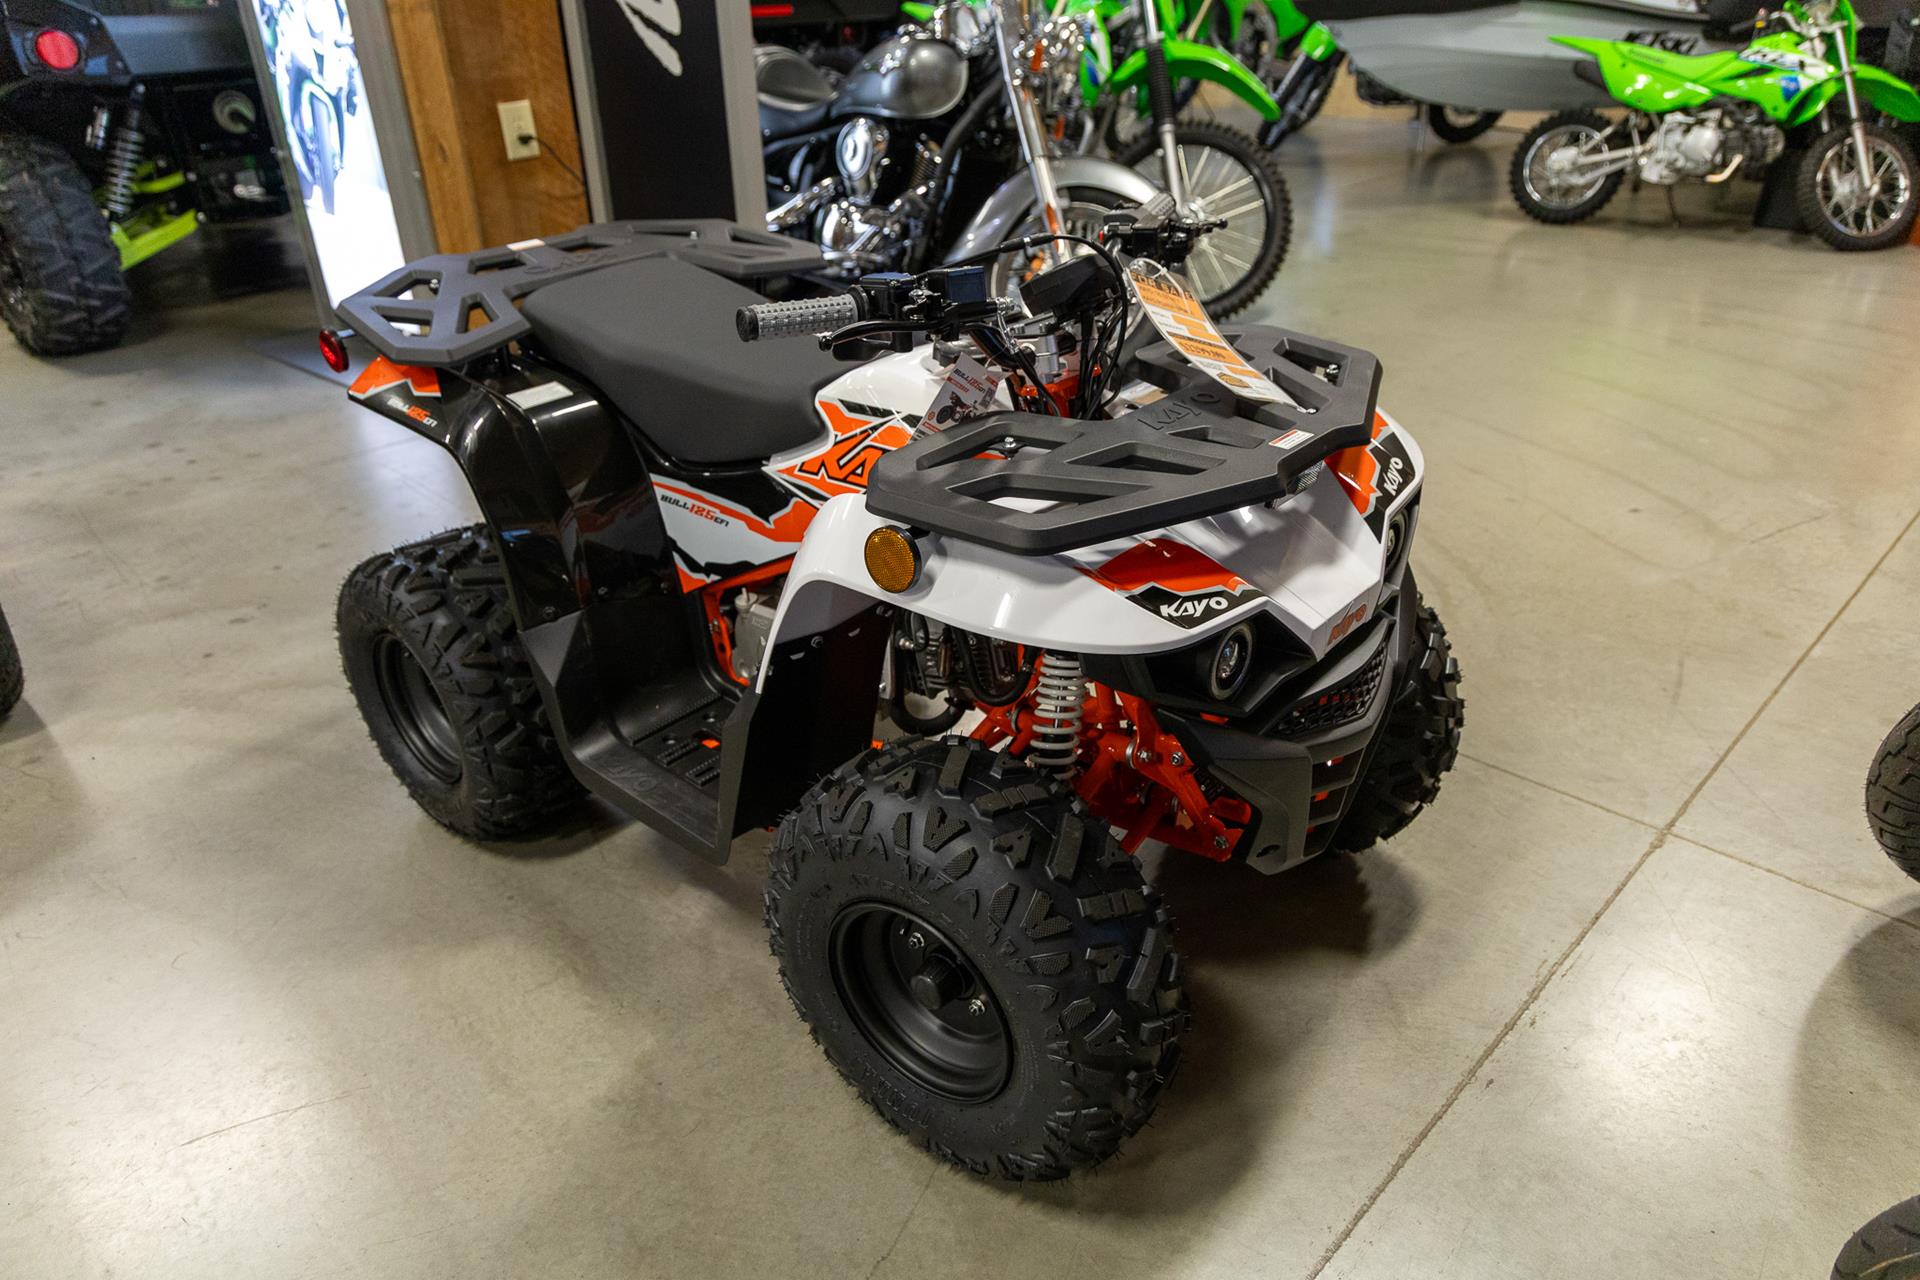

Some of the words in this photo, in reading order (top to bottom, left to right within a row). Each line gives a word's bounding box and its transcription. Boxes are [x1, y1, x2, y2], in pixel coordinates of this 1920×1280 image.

[1159, 280, 1195, 302] SAE
[1383, 457, 1404, 496] KAYO
[1159, 596, 1229, 618] KAYO
